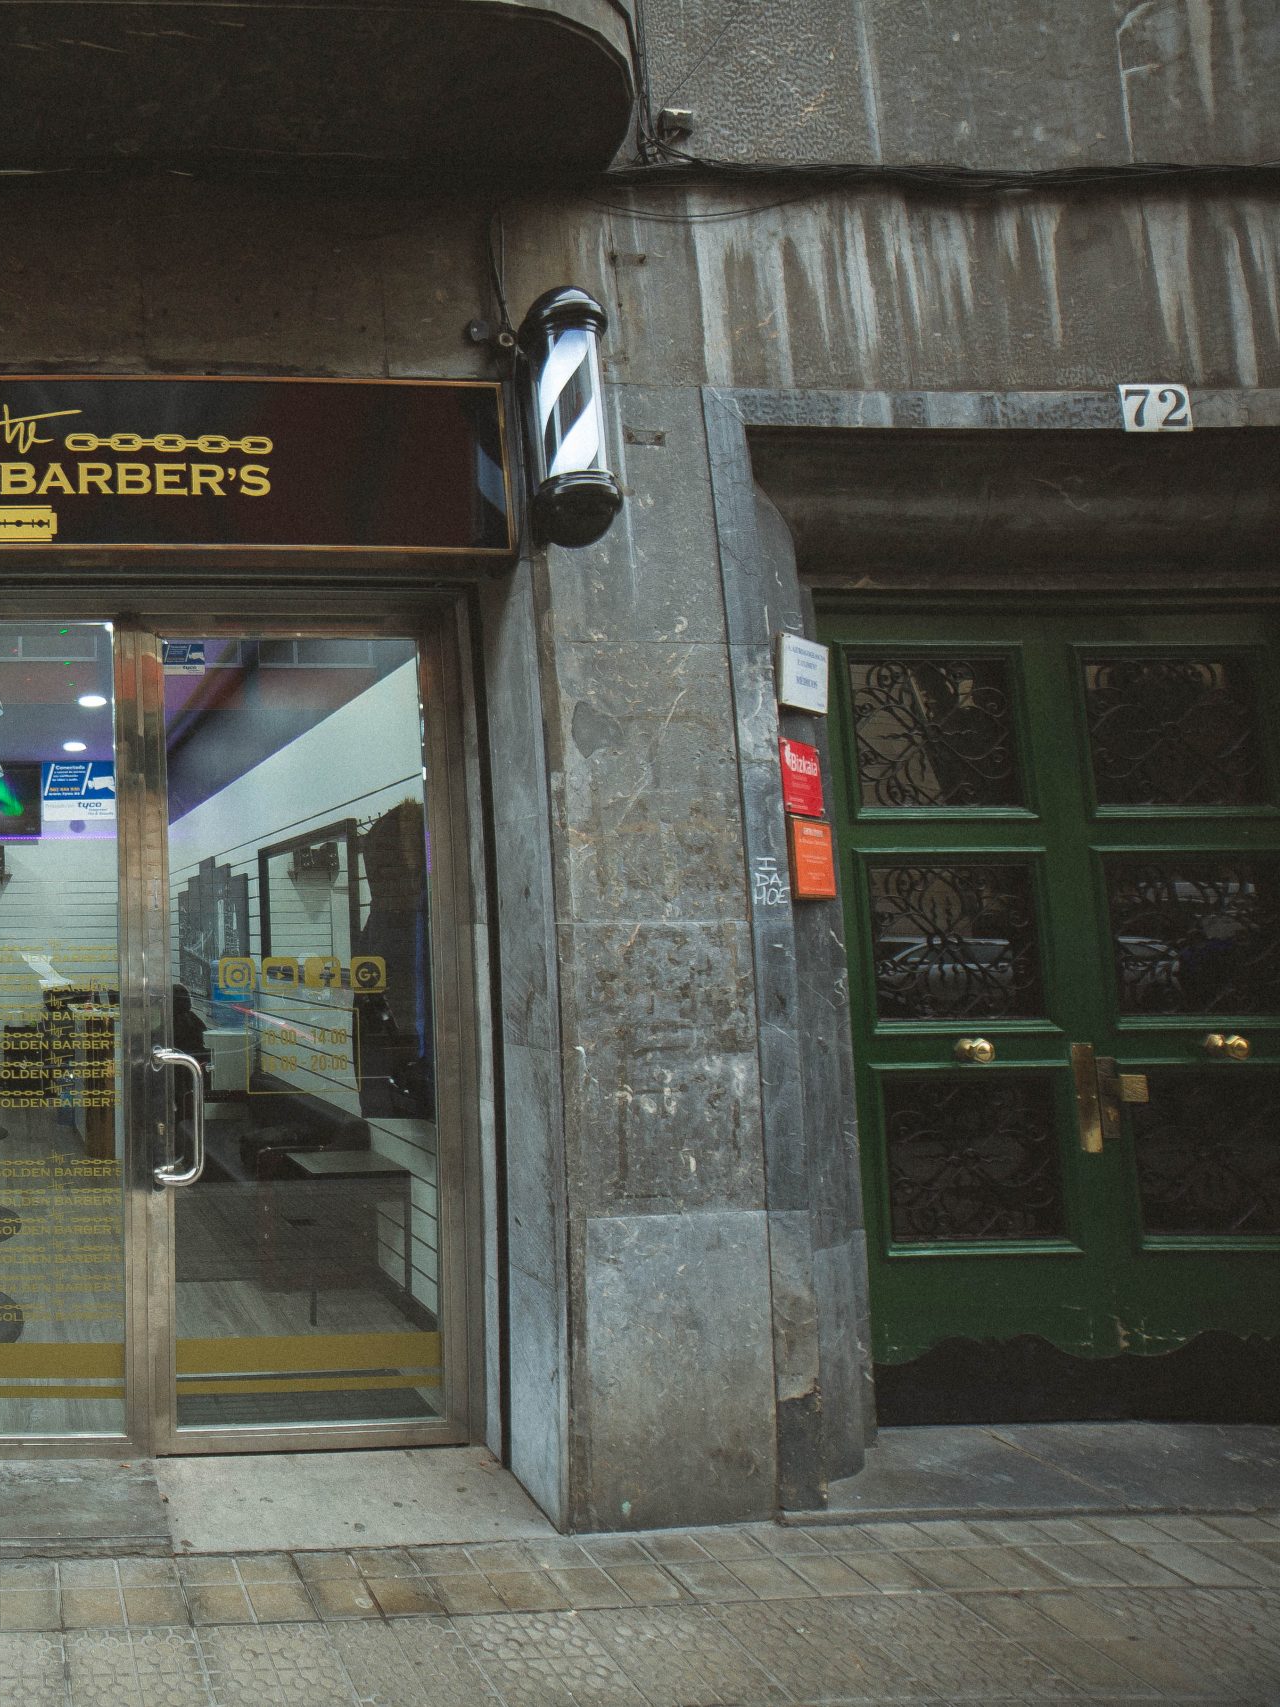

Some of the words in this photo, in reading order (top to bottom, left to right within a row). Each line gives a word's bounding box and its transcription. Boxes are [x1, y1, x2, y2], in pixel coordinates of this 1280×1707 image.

[1123, 388, 1189, 428] 72
[0, 462, 271, 497] BARBER'S
[791, 752, 818, 776] Bizkaia
[52, 1040, 120, 1050] BARBER'S
[52, 1098, 120, 1108] BARBER'S
[55, 1167, 122, 1177] BARBER'S
